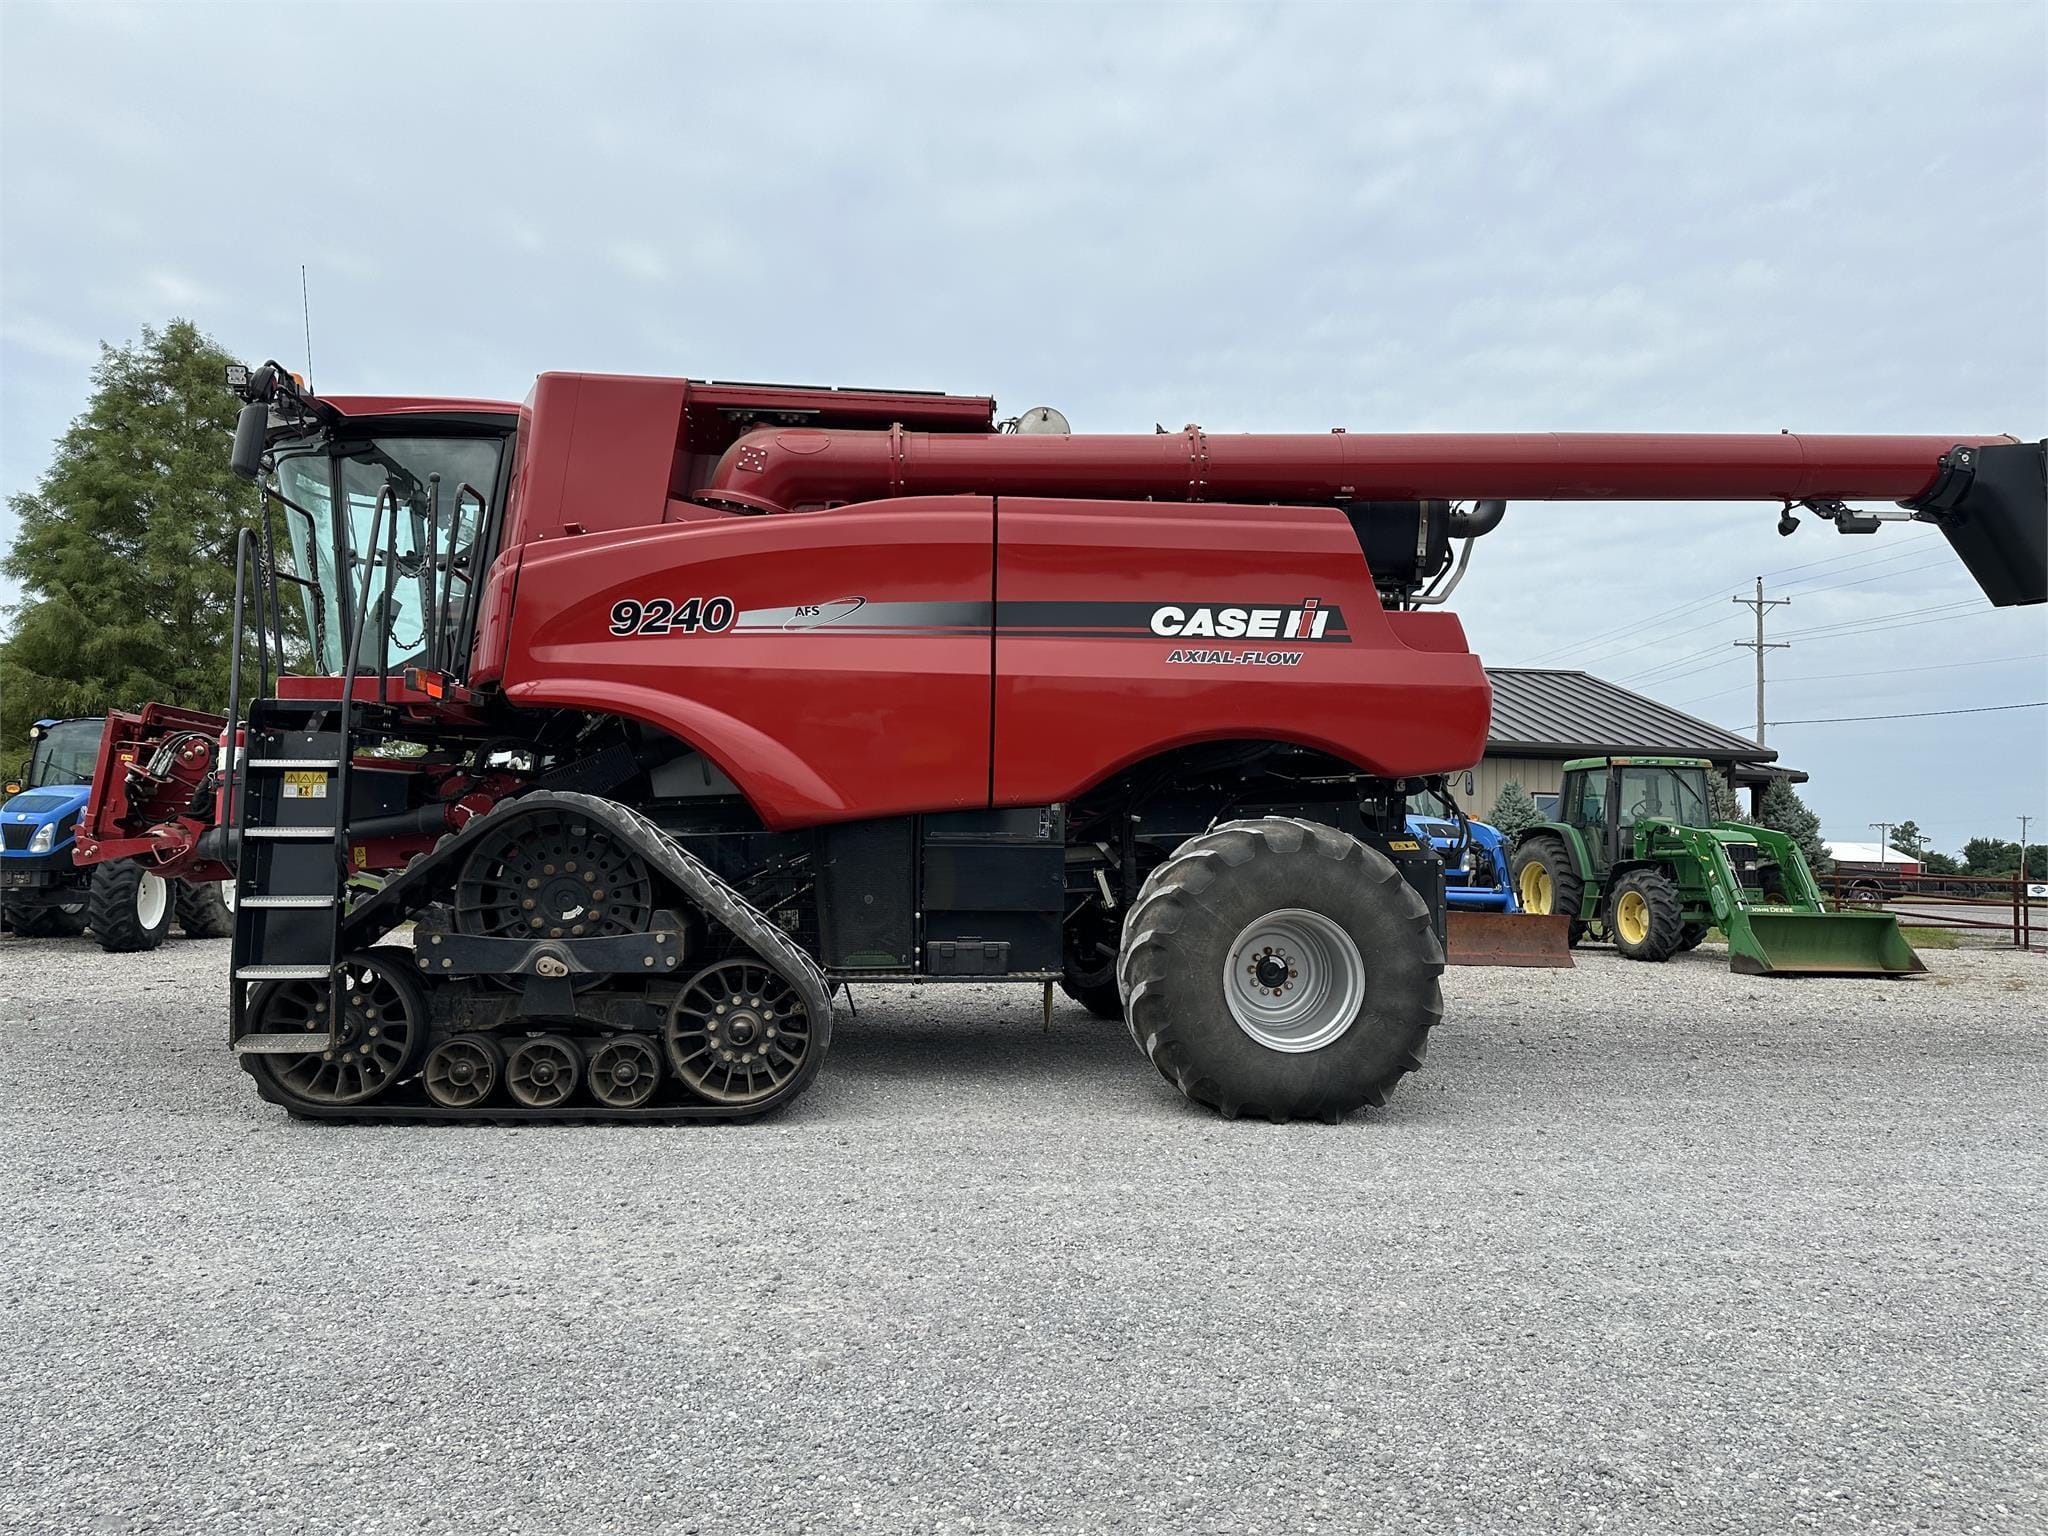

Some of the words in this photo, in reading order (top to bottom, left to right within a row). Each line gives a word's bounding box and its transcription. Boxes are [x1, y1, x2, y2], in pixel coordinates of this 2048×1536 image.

[609, 596, 734, 636] 9240
[794, 605, 820, 617] AFS
[1150, 606, 1282, 638] CASE
[1166, 649, 1303, 666] AXIAL-FLOW
